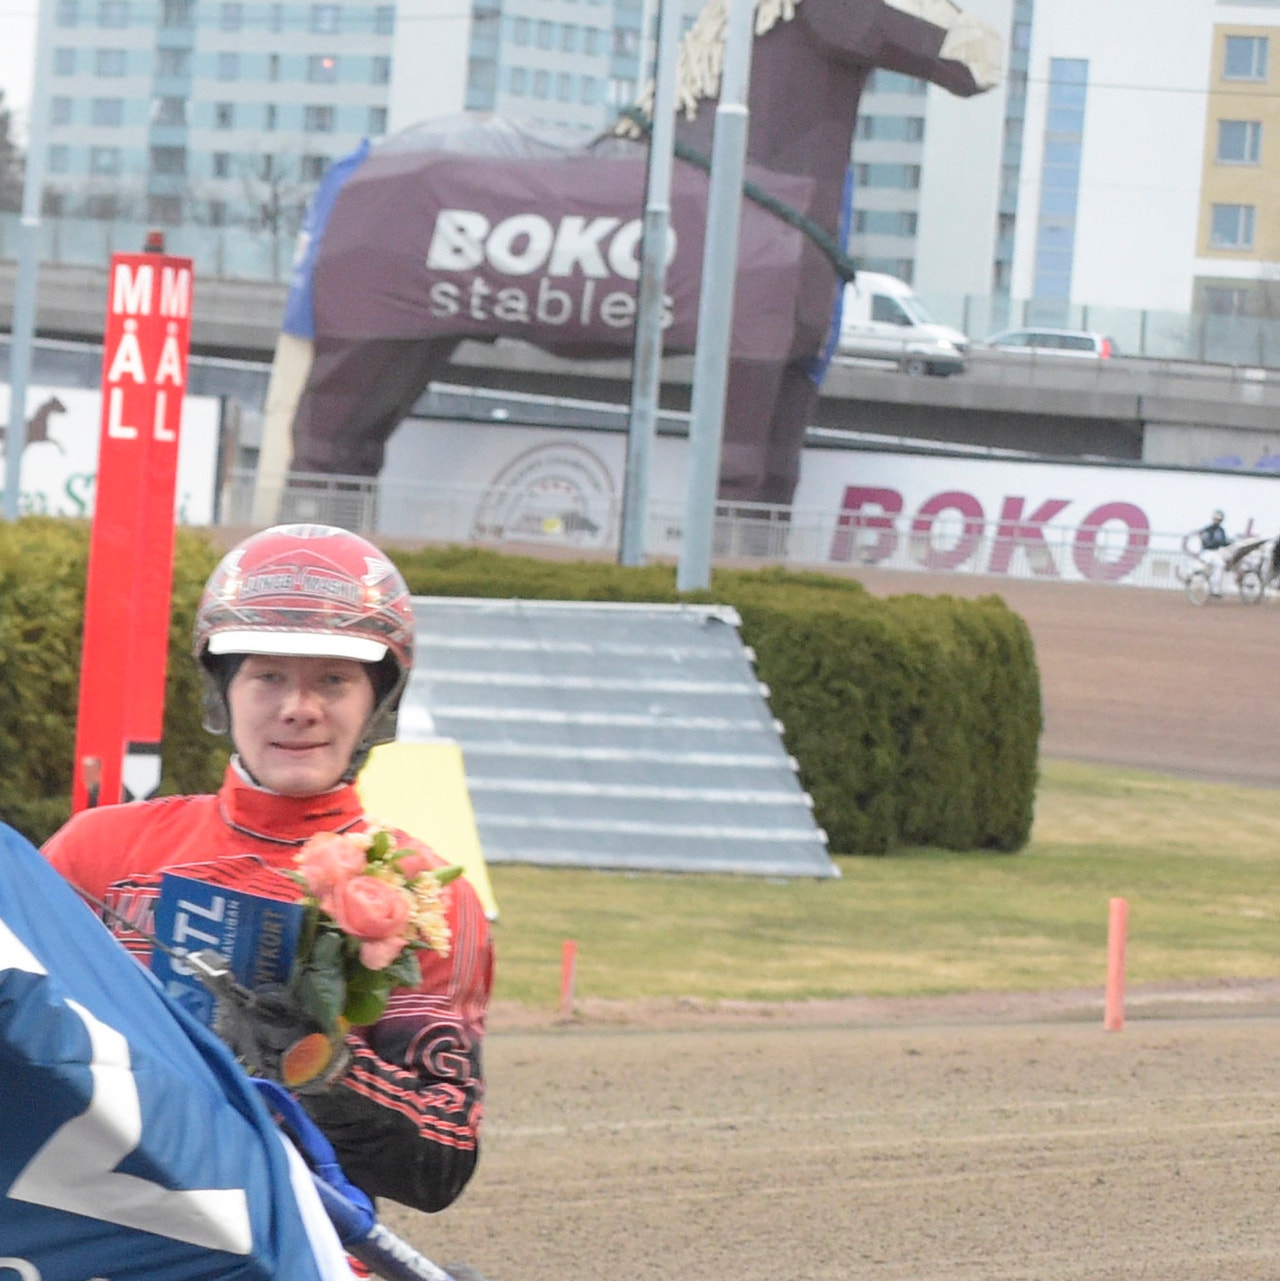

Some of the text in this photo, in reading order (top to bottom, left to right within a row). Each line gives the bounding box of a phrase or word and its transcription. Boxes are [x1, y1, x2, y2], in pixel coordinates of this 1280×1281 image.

[426, 208, 677, 280] BOKO
[428, 276, 676, 330] stables
[830, 484, 1151, 583] BOKO
